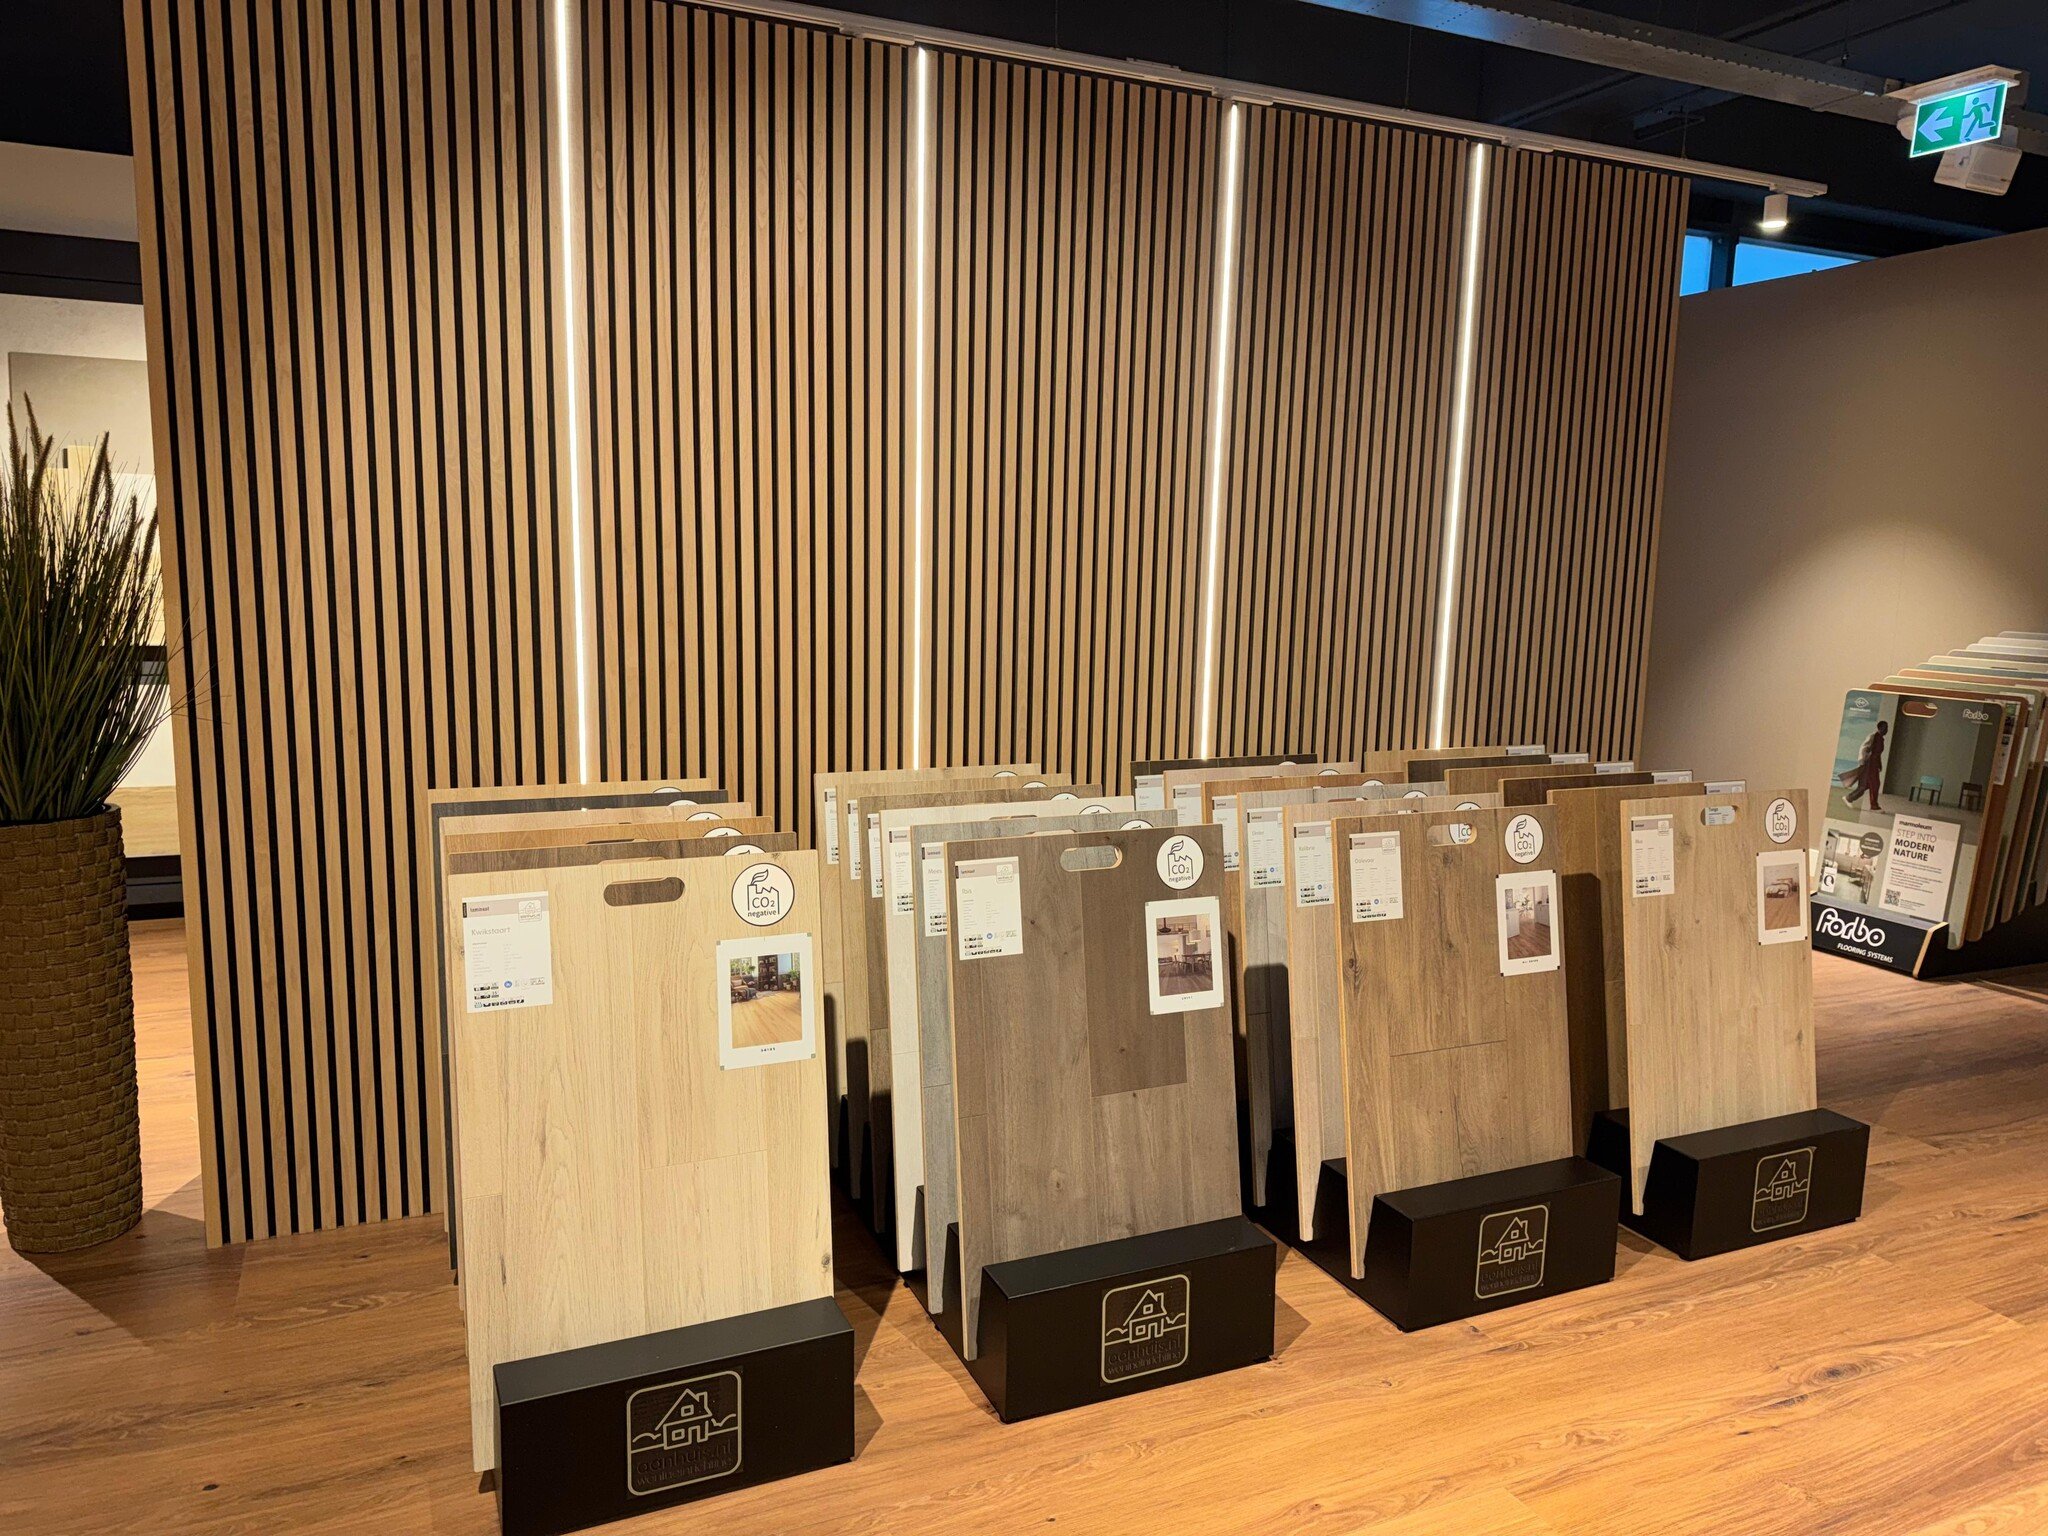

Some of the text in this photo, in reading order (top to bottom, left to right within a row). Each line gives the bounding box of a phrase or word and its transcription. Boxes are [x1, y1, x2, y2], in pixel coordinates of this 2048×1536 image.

[1896, 828, 1937, 843] STEP INTO
[1895, 838, 1935, 853] MODERN
[1893, 847, 1929, 862] NATURE
[1171, 864, 1190, 875] CO2
[1168, 875, 1191, 883] negative
[752, 896, 776, 909] CO2
[747, 909, 777, 918] negative
[1837, 942, 1894, 963] FLOORING SYSTEMS
